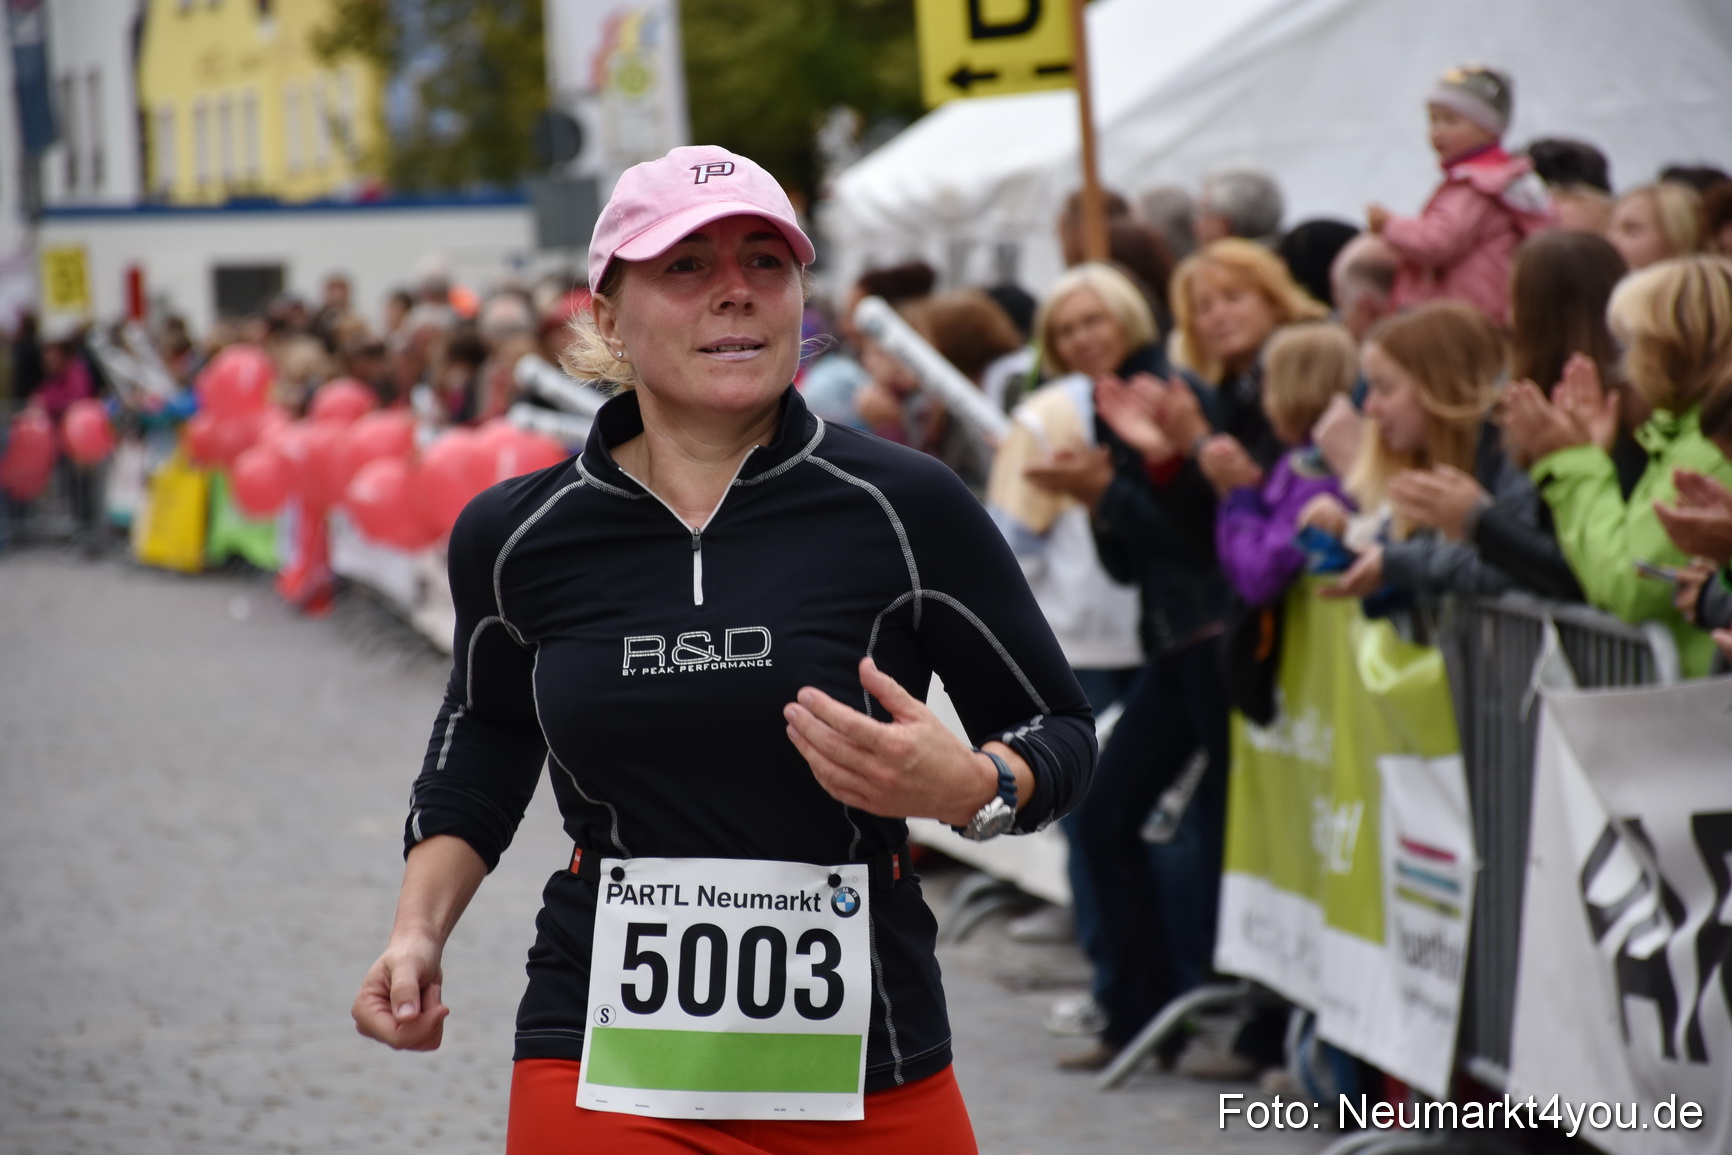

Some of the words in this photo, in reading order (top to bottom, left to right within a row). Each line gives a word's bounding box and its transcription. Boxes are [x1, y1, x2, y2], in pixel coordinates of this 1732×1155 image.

[690, 161, 735, 184] P
[623, 626, 771, 668] R&D
[622, 668, 636, 676] BY
[642, 666, 674, 675] PEAK
[679, 659, 773, 673] PERFORMANCE
[605, 883, 689, 906] PARTL
[697, 885, 821, 912] Neumarkt
[620, 922, 845, 1020] 5003
[599, 1008, 610, 1023] S
